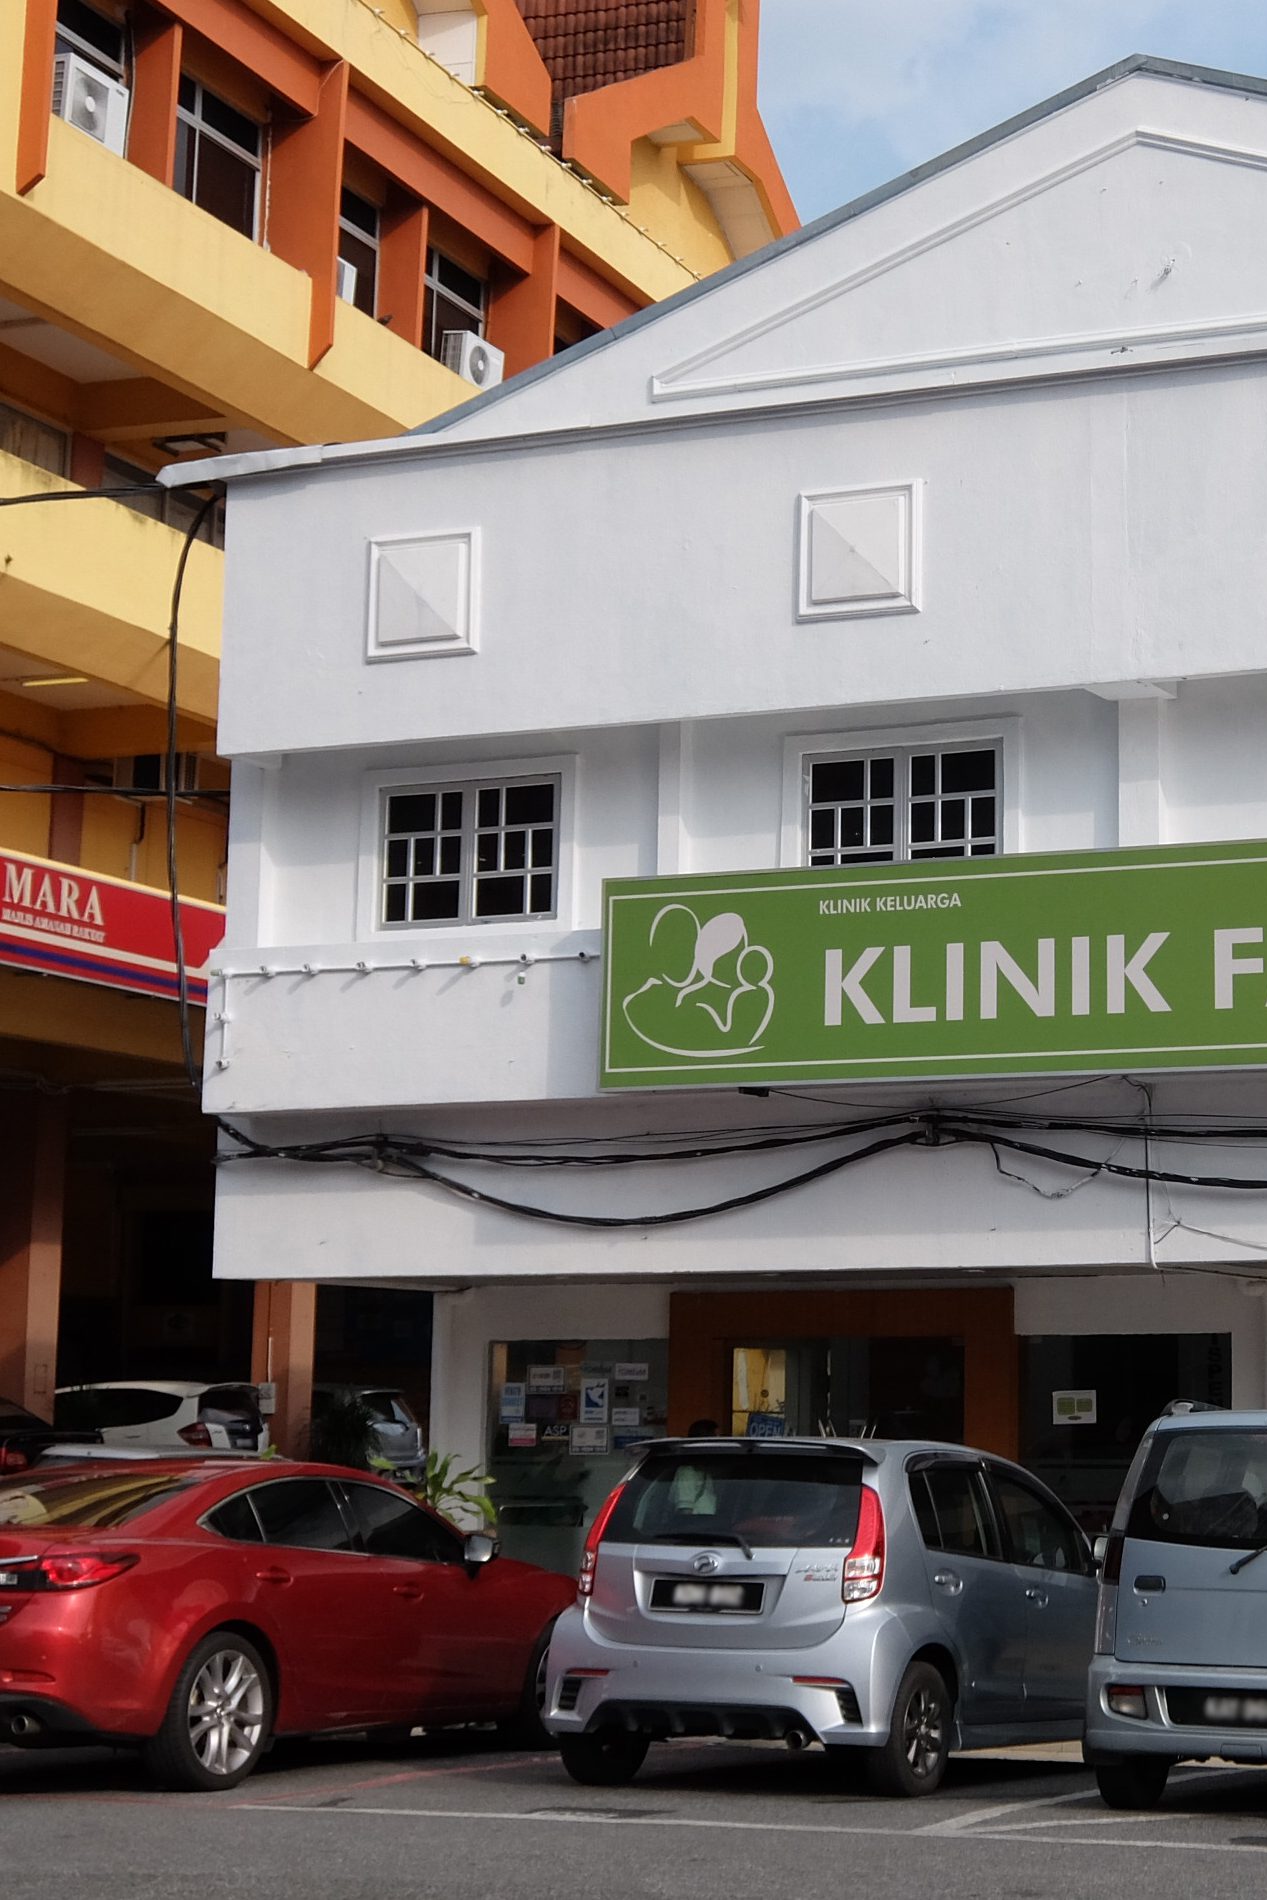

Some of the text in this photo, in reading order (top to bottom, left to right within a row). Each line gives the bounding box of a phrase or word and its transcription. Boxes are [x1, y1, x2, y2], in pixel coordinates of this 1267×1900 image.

[3, 862, 104, 926] MARA
[819, 893, 961, 914] KLINIK KELUARGA
[823, 931, 1172, 1026] KLINIK
[544, 1425, 567, 1436] ASP
[750, 1422, 782, 1438] OPEN
